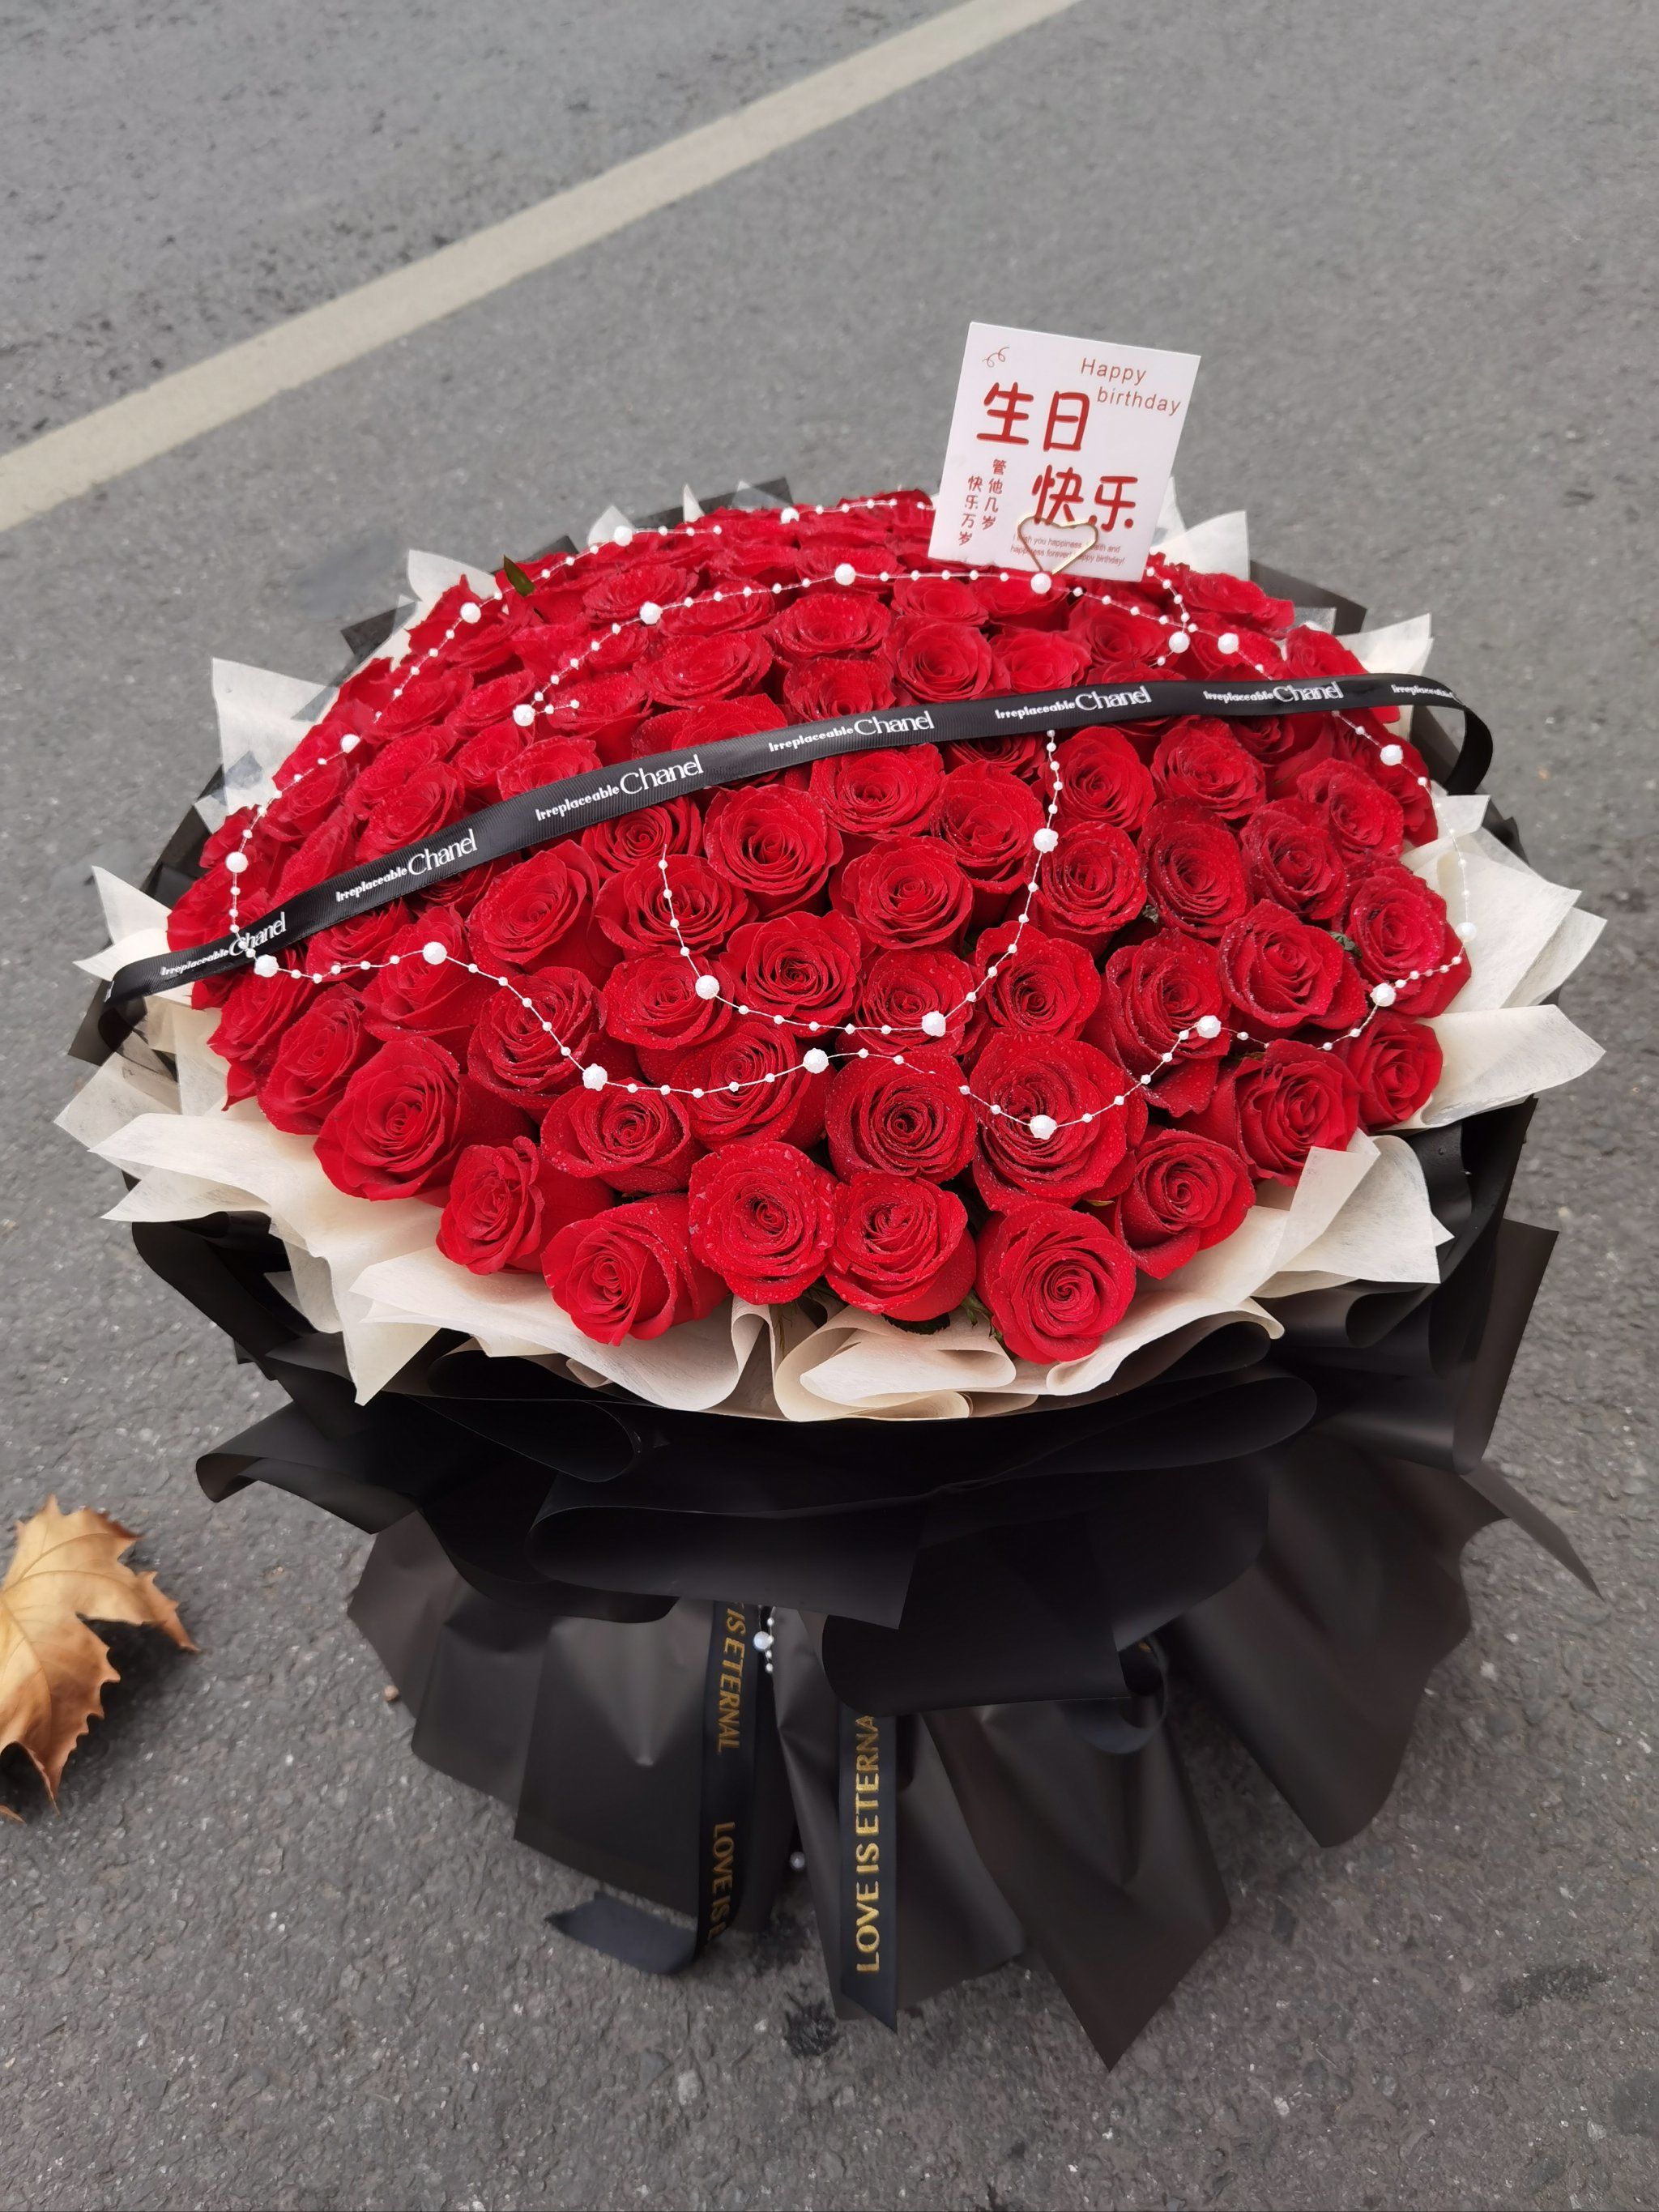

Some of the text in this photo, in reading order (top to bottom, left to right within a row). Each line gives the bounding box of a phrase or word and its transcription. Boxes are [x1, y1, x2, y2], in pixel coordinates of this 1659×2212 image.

[1081, 357, 1146, 386] Happy
[1097, 386, 1181, 416] birthday
[976, 382, 1090, 452] 生日
[958, 475, 983, 546] 快乐万岁
[981, 458, 1007, 531] 管他几岁
[1031, 464, 1138, 532] 快乐
[1034, 536, 1047, 547] you
[716, 1609, 746, 1754] IS ETERNAL
[712, 1822, 736, 1895] LOVE
[856, 1842, 879, 1874] IS
[710, 1895, 731, 1923] IS
[856, 1881, 879, 1974] LOVE
